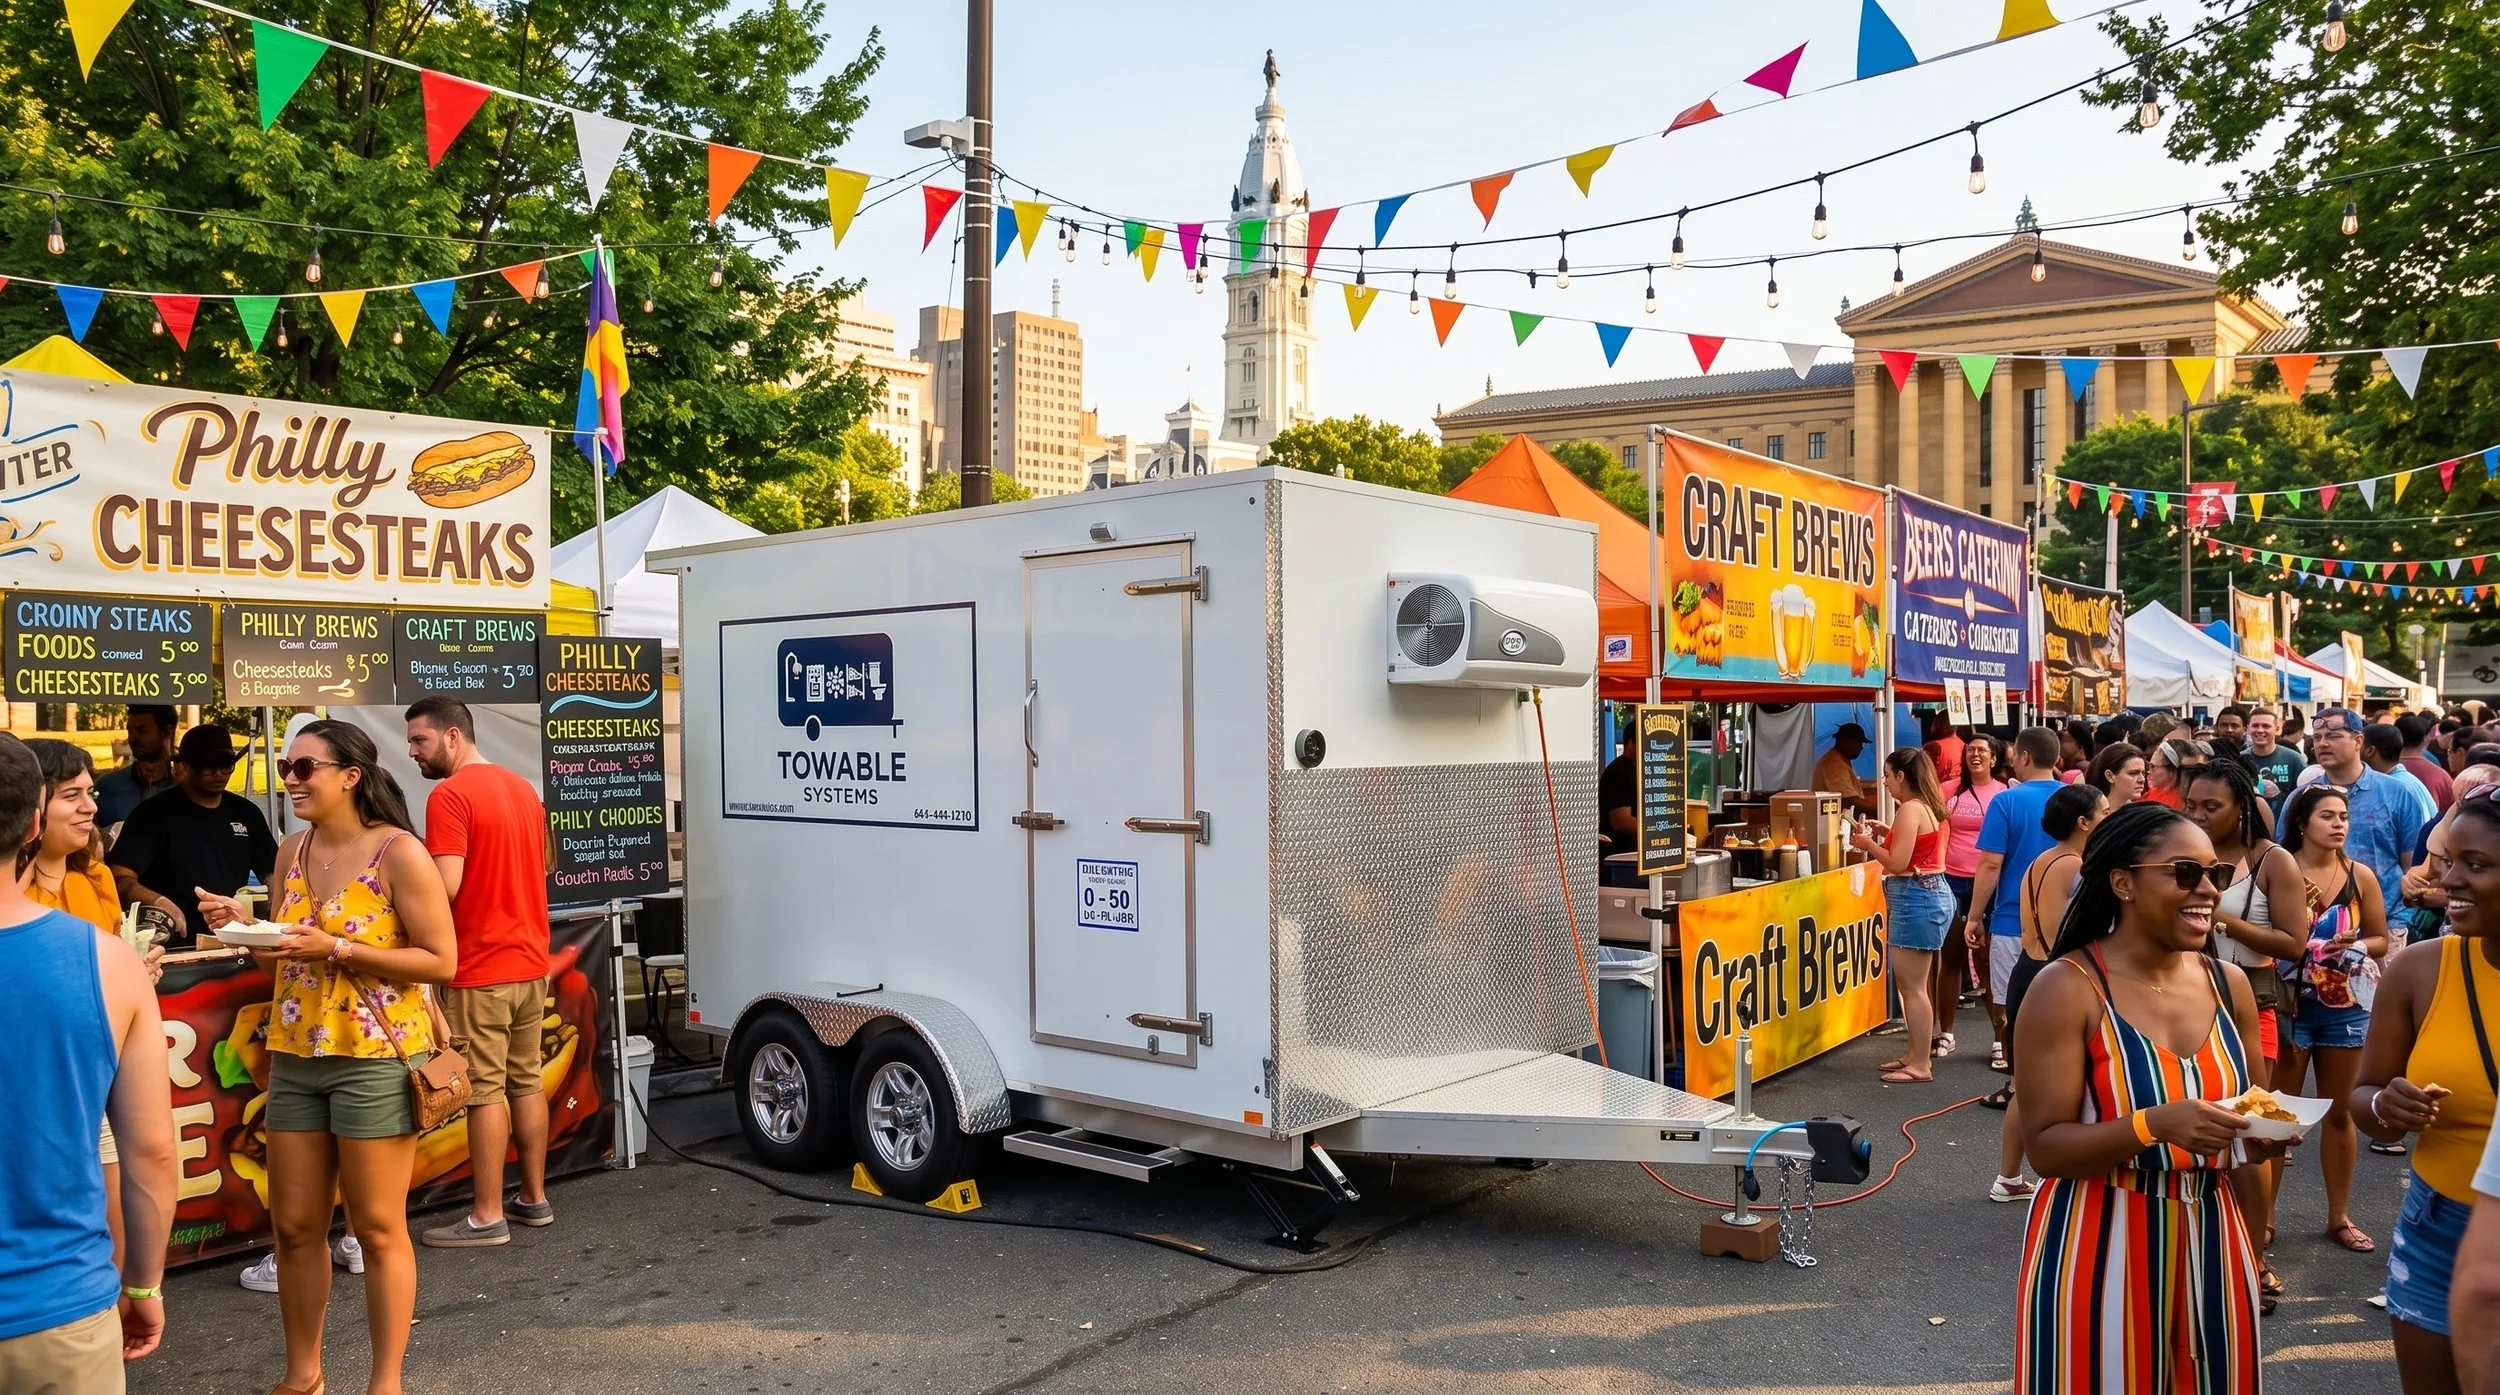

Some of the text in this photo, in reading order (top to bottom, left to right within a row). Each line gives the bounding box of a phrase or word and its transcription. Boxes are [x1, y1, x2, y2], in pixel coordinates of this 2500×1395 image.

[146, 401, 396, 509] Philly
[97, 494, 535, 586] CHEESESTEAKS
[1682, 473, 1876, 588] CRAFT BREWS
[1903, 511, 1954, 585] BEERS
[17, 601, 192, 633] CROINY STEAKS
[241, 612, 379, 639] PHILLY BREWS
[406, 618, 535, 641] CRAFT BREWS
[18, 633, 96, 660] FOODS
[560, 643, 641, 670] PHILLY
[233, 659, 332, 679] Cheesesteaks
[546, 672, 651, 691] CHEESETEAKS
[16, 669, 160, 697] CHEESESTEAKS
[546, 718, 660, 739] CHEESESTEAKS
[777, 751, 907, 782] TOWABLE
[803, 787, 878, 805] SYSTEMS
[550, 806, 663, 830] PHILY CHOODES
[1109, 889, 1130, 909] 50
[1694, 911, 1884, 1047] Craft Brews
